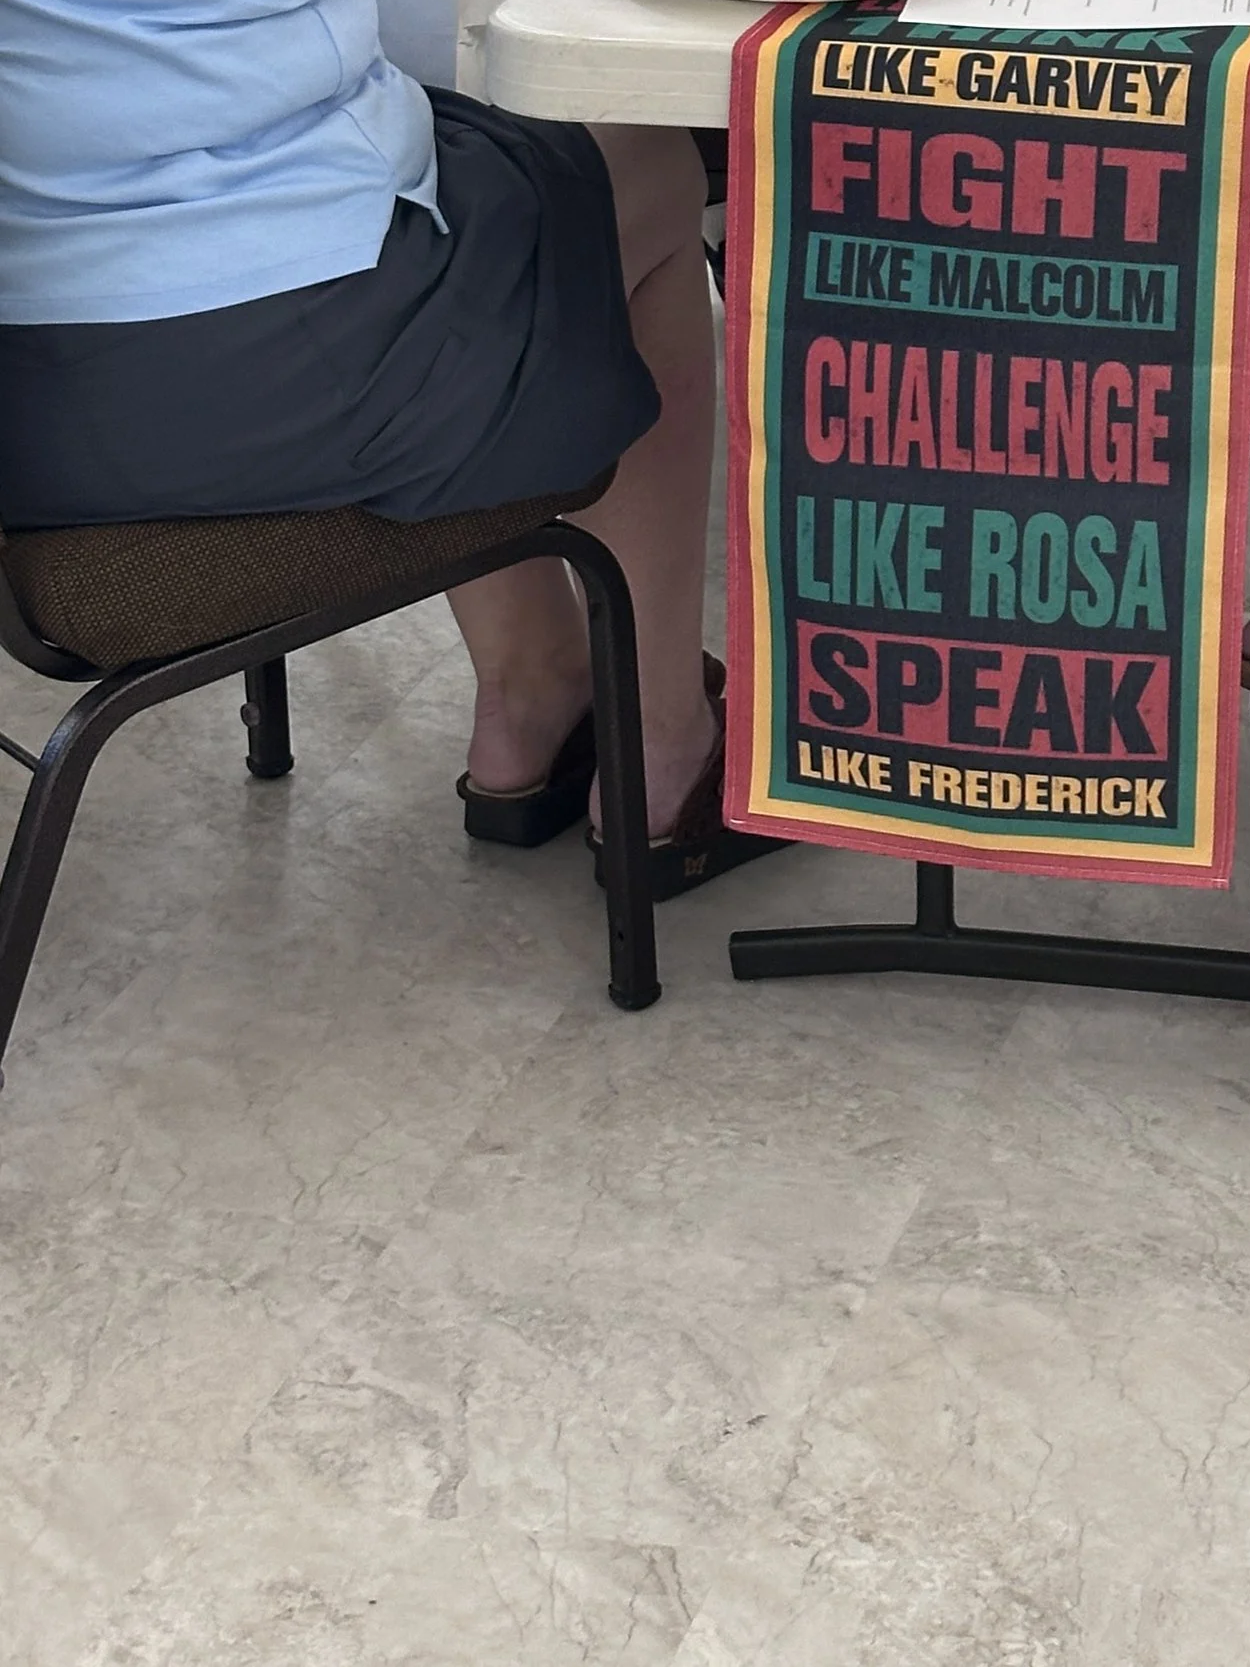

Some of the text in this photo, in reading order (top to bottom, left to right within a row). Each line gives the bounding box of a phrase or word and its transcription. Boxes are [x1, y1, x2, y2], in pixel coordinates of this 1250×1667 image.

[822, 43, 1184, 117] LIKE GARVEY
[811, 121, 1187, 244] FIGHT
[814, 237, 1165, 324] LIKE MALCOLM
[804, 336, 1173, 486] CHALLENGE
[797, 495, 1168, 631] LIKE ROSA
[808, 632, 1157, 755] SPEAK
[797, 740, 1168, 819] LIKE FREDERICK
